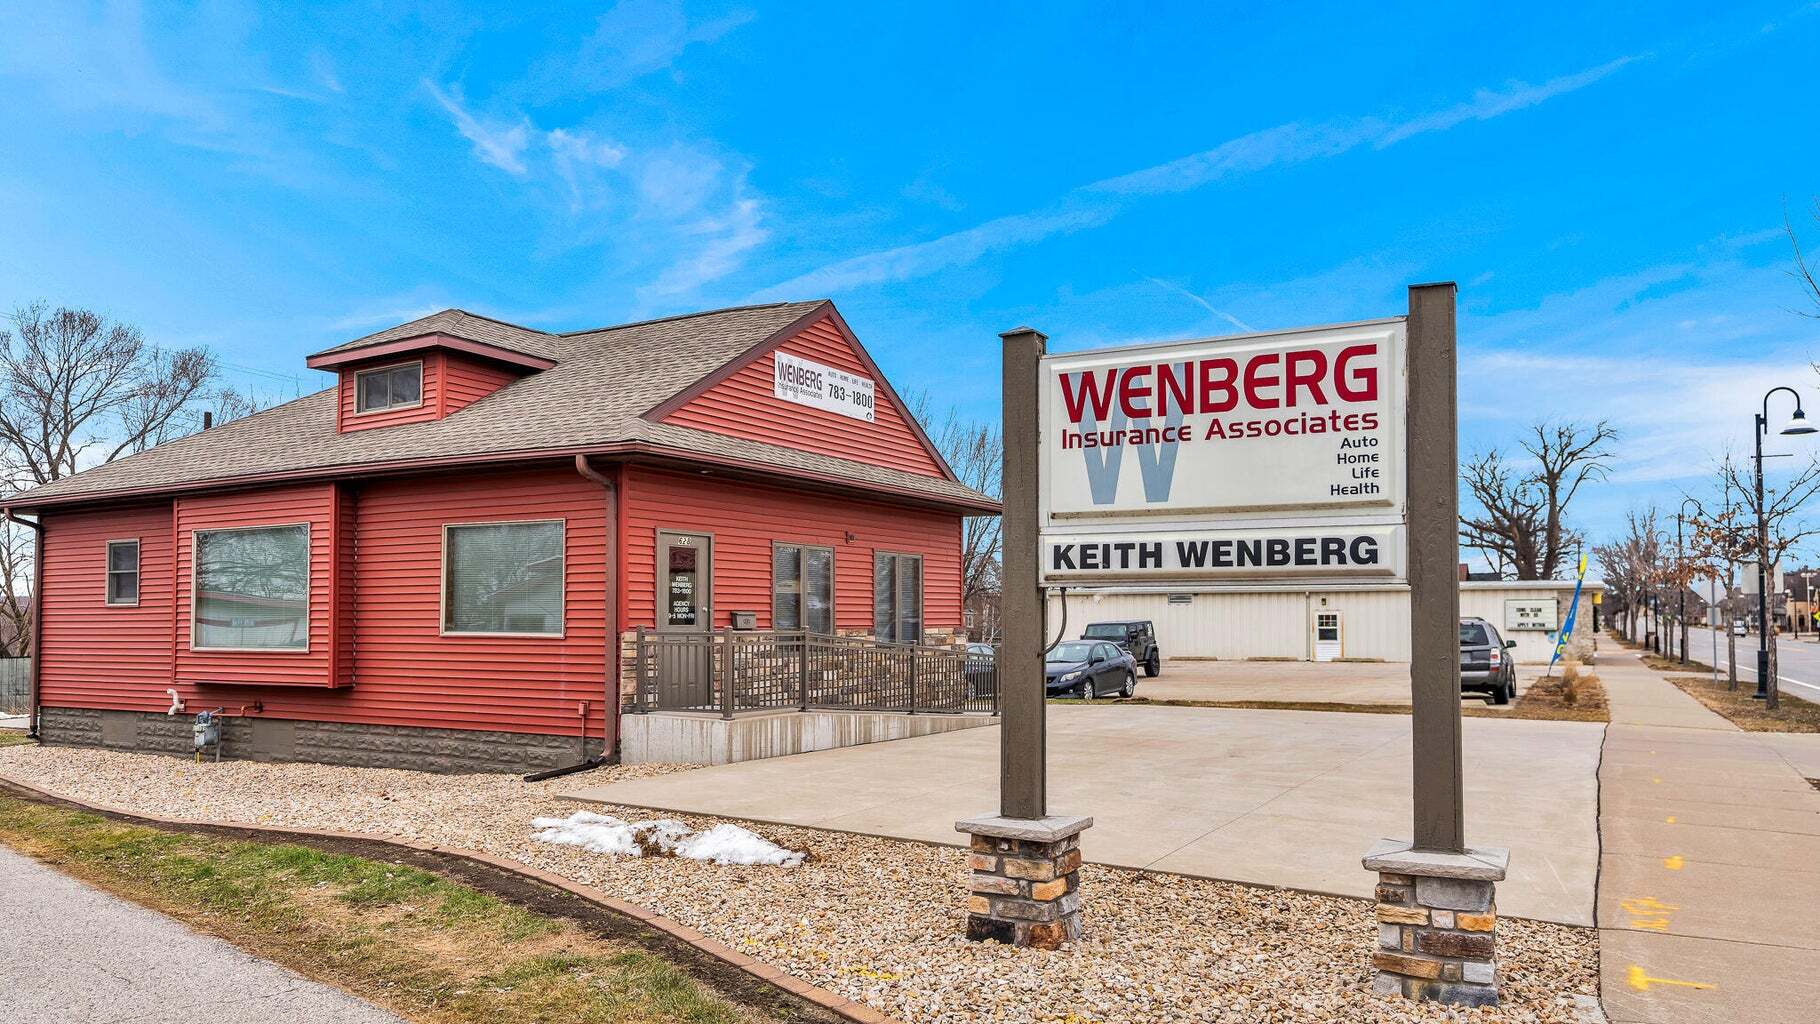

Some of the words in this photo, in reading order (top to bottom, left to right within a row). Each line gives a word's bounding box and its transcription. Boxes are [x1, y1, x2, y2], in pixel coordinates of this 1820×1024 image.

[777, 361, 823, 391] WENBERG
[1058, 343, 1379, 424] WENBERG
[777, 382, 799, 394] Insurance
[800, 387, 823, 400] Associates
[828, 383, 873, 409] 783-1800
[1062, 425, 1192, 450] Insurance
[1205, 410, 1379, 441] Associates
[1340, 436, 1379, 450] Auto
[1337, 452, 1379, 464] Home
[1352, 467, 1379, 479] Life
[1330, 482, 1379, 496] Health
[1052, 542, 1163, 570] KEITH
[1176, 535, 1379, 568] WENBERG
